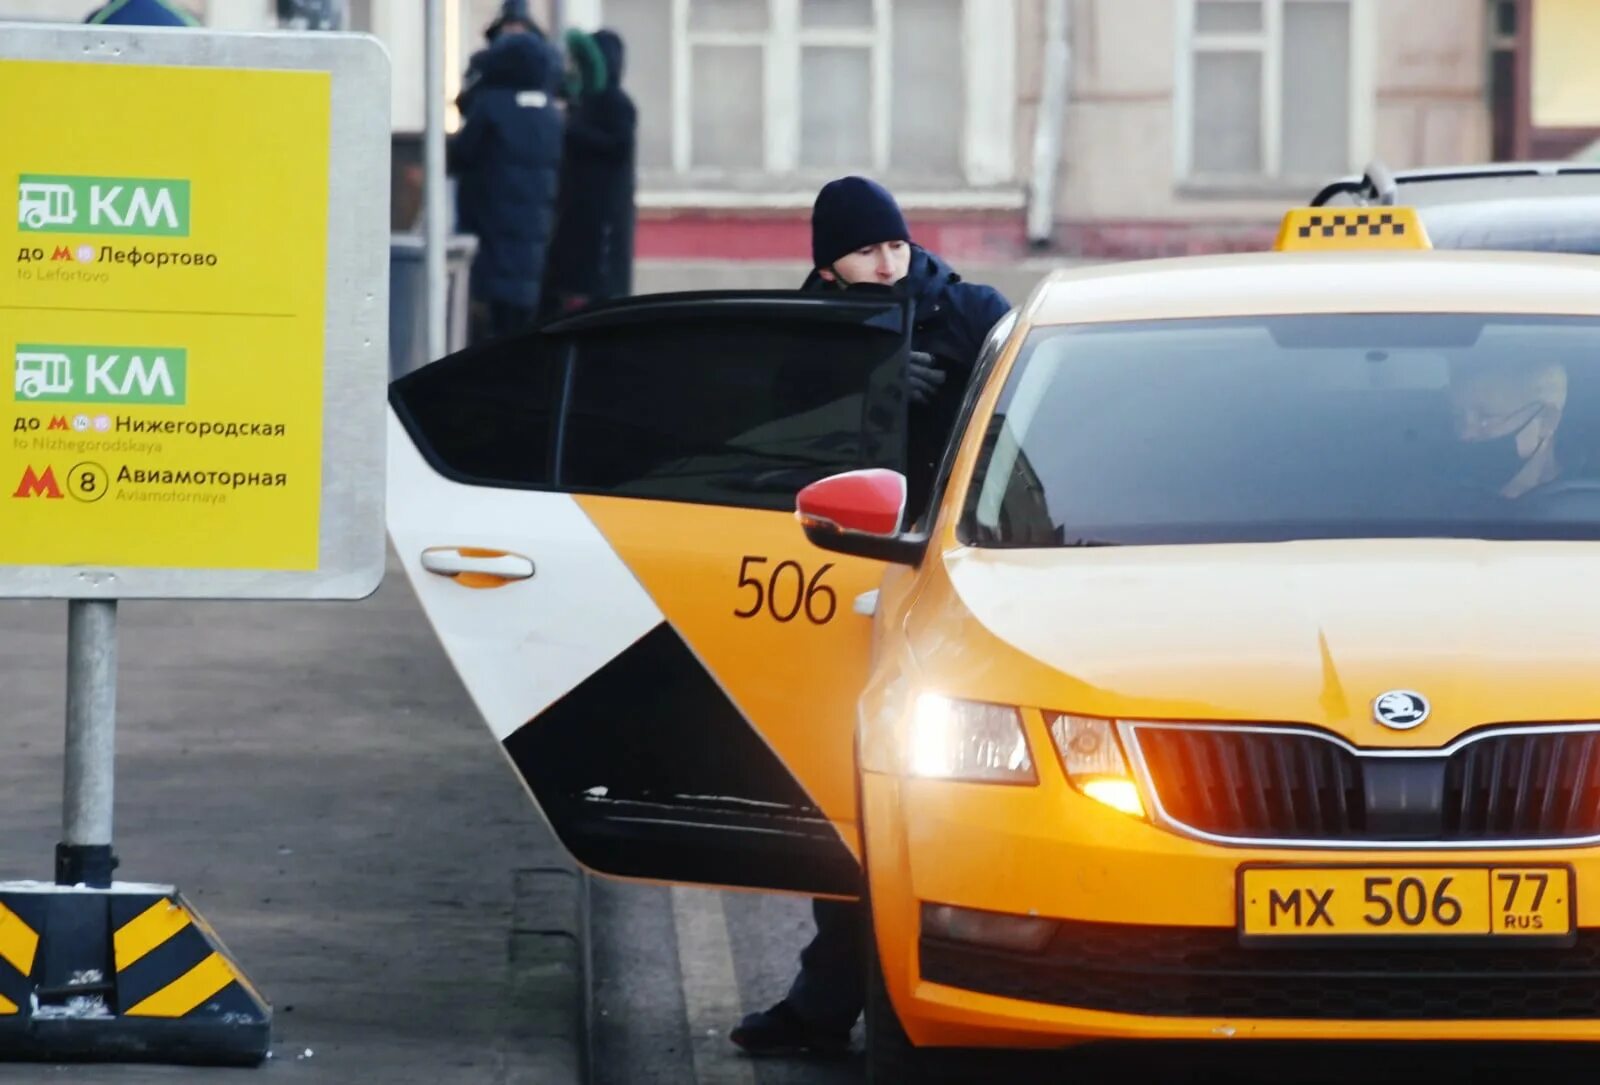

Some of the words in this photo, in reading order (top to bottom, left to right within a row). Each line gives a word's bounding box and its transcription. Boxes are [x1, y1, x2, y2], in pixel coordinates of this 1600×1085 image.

[89, 185, 179, 228] КМ
[17, 247, 44, 262] до
[98, 246, 218, 268] Лефортово
[17, 268, 32, 280] to
[37, 268, 109, 283] Lefortovo
[86, 354, 175, 396] КМ
[13, 417, 40, 432] до
[115, 416, 286, 438] Нижегородская
[13, 437, 28, 449] to
[33, 437, 163, 456] Nizhegorodskaya
[116, 465, 287, 488] Авиамоторная
[116, 489, 227, 504] Aviamotornaya
[733, 555, 837, 625] 506
[1363, 877, 1462, 926] 506
[1497, 873, 1549, 911] 77
[1504, 915, 1544, 929] RUS
